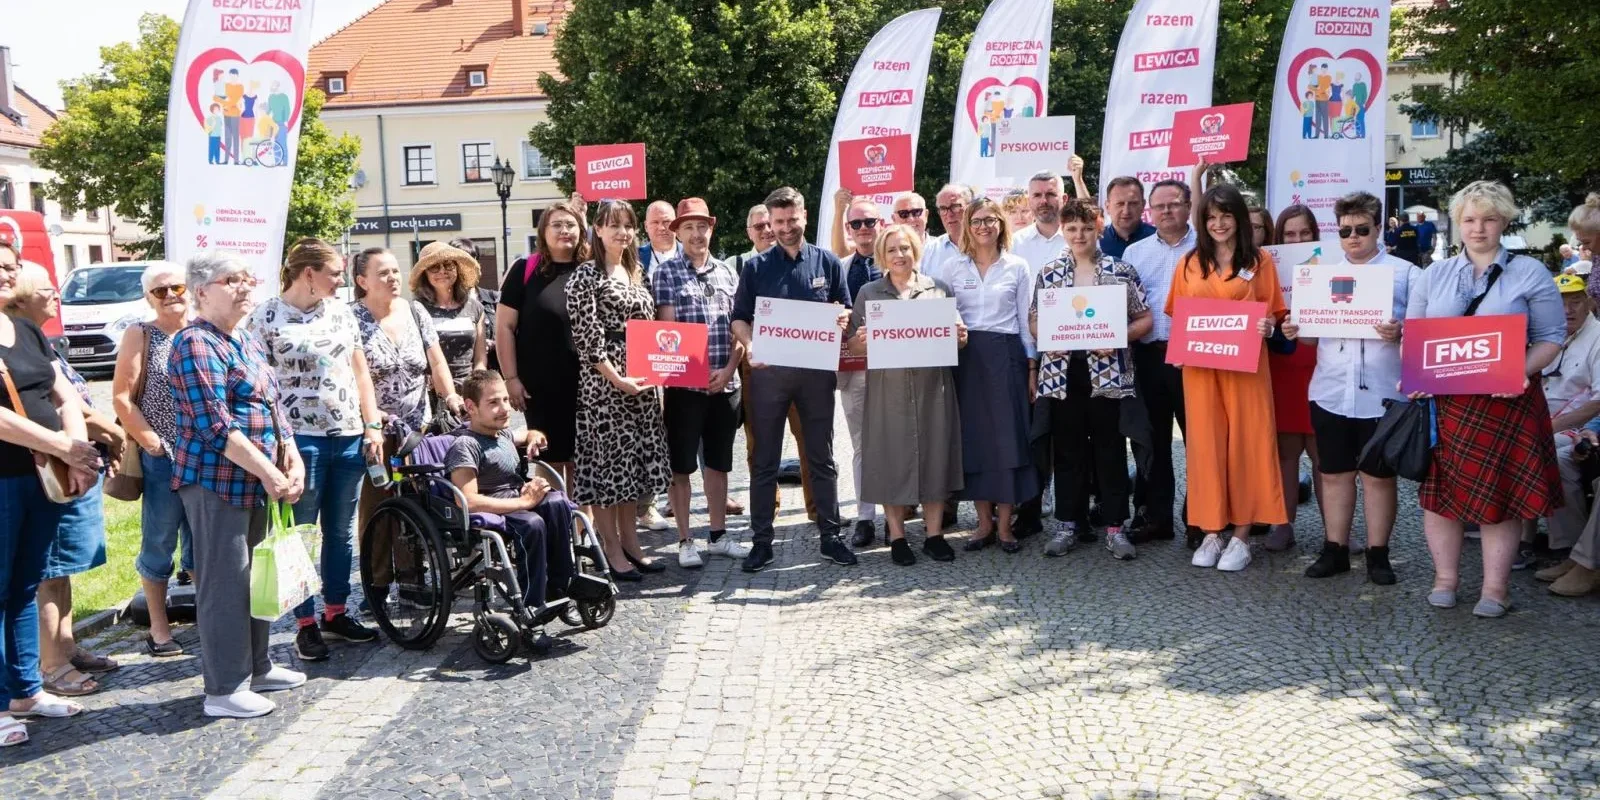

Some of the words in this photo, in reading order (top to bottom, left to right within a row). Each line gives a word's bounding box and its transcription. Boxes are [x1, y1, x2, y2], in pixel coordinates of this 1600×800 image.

[1309, 6, 1380, 18] BEZPIECZNA
[223, 16, 290, 31] RODZINA
[1146, 14, 1193, 27] razem
[1316, 22, 1371, 35] RODZINA
[985, 40, 1044, 51] BEZPIECZNA
[991, 54, 1036, 65] RODZINA
[1137, 50, 1197, 69] LEWICA
[873, 60, 910, 71] razem
[861, 91, 910, 106] LEWICA
[1140, 93, 1188, 105] razem
[861, 125, 902, 136] razem
[1189, 134, 1230, 144] BEZPIECZNA
[1001, 141, 1069, 152] PYSKOWICE
[1193, 142, 1224, 151] RODZINA
[590, 157, 631, 171] LEWICA
[858, 165, 895, 175] BEZPIECZNA
[862, 174, 891, 182] RODZINA
[1136, 170, 1186, 182] razem
[591, 179, 631, 190] razem
[390, 218, 454, 229] OKULISTA
[1058, 324, 1091, 332] OBNIŻKA
[1190, 317, 1244, 329] LEWICA
[759, 325, 836, 342] PYSKOWICE
[872, 327, 951, 340] PYSKOWICE
[1086, 332, 1115, 340] PALIWA
[1187, 340, 1239, 356] razem
[1436, 339, 1490, 363] FMS
[647, 354, 690, 363] BEZPIECZNA
[653, 363, 686, 371] RODZINA
